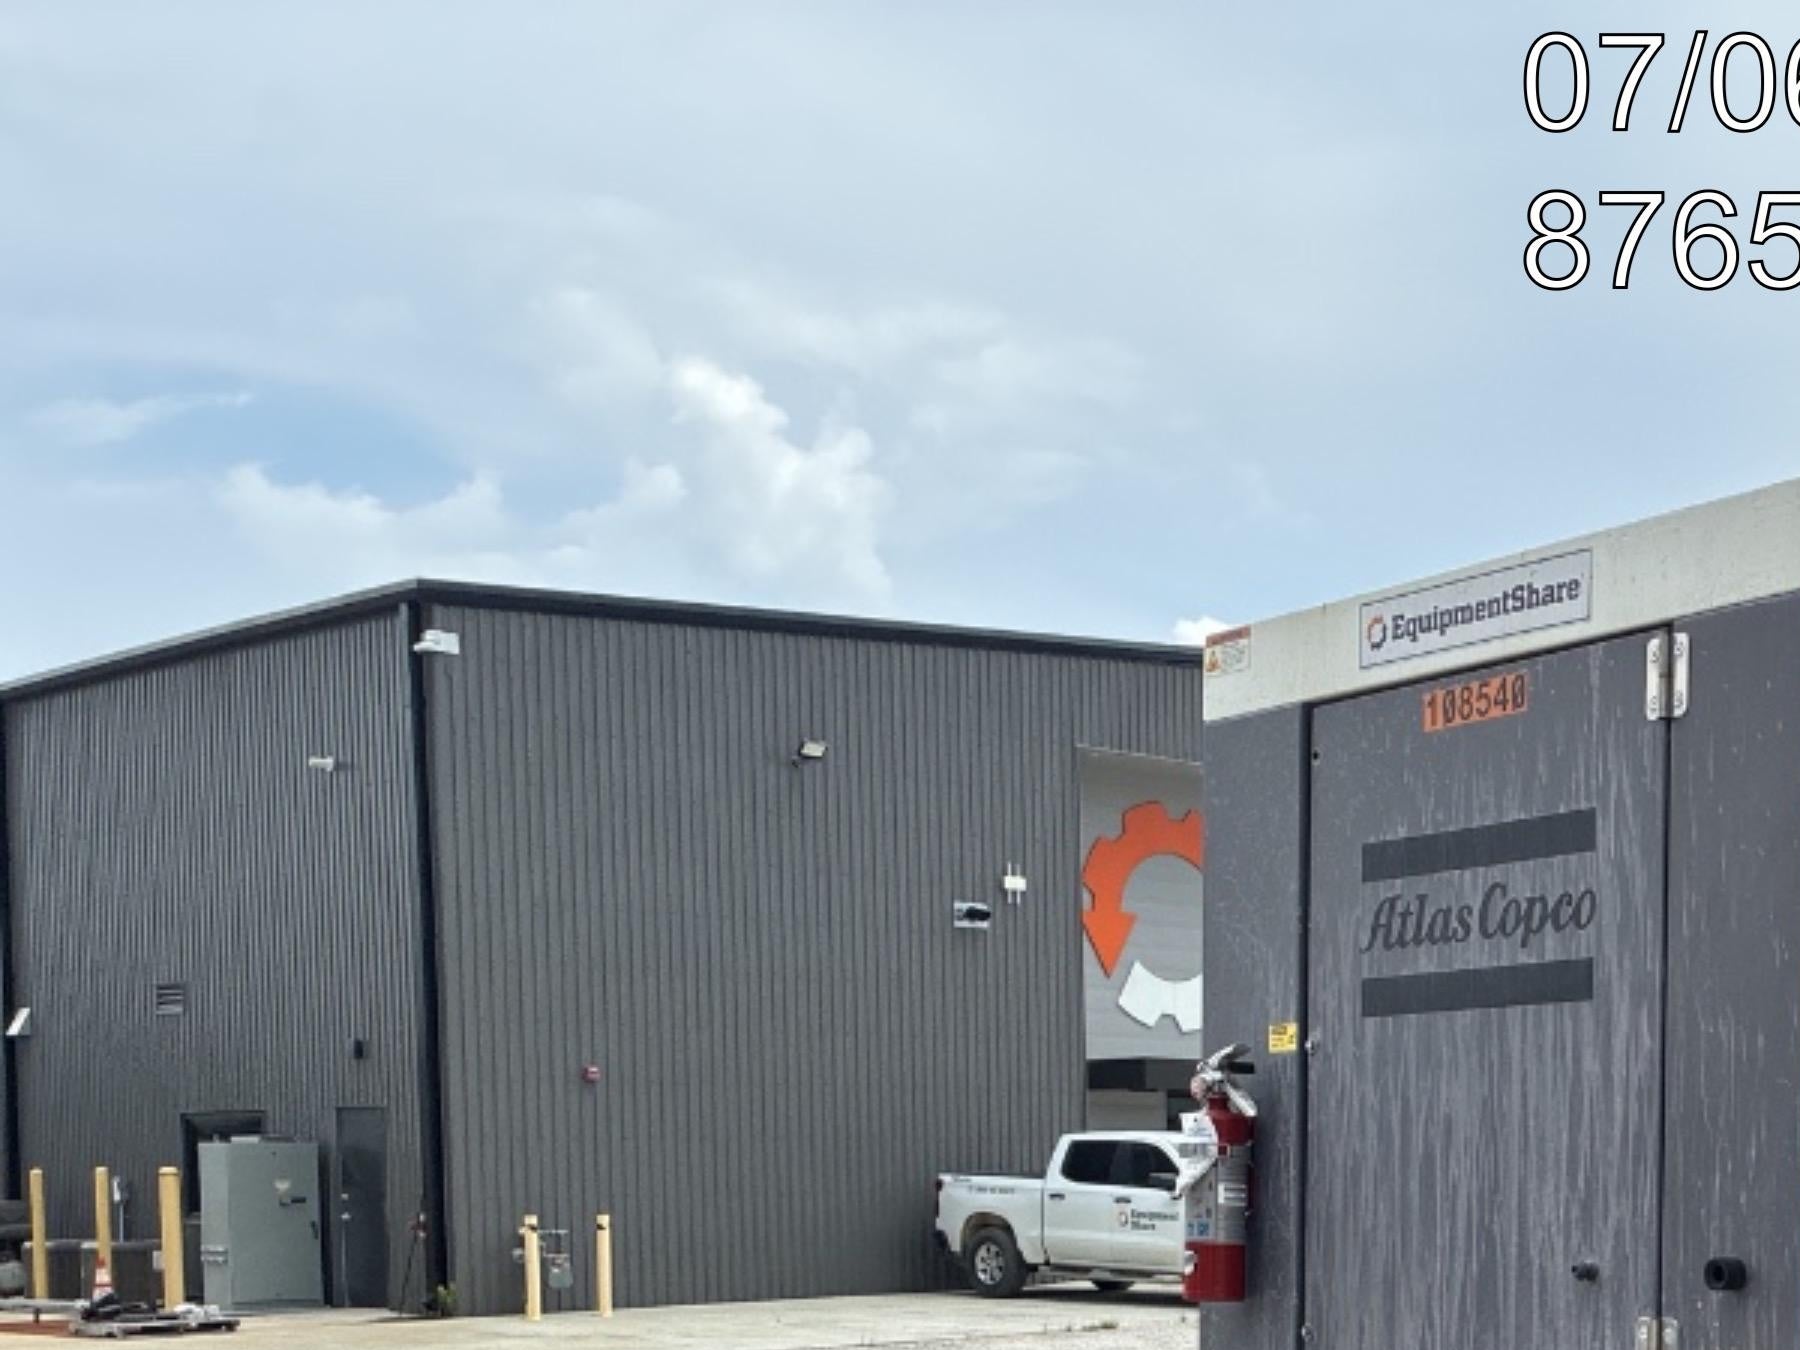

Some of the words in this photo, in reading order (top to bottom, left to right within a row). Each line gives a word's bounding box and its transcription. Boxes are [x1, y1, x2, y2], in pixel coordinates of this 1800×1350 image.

[1391, 577, 1582, 643] EquipmentShare
[1426, 673, 1526, 728] 108540
[1360, 893, 1474, 954] Atlas
[1478, 881, 1598, 949] Copco
